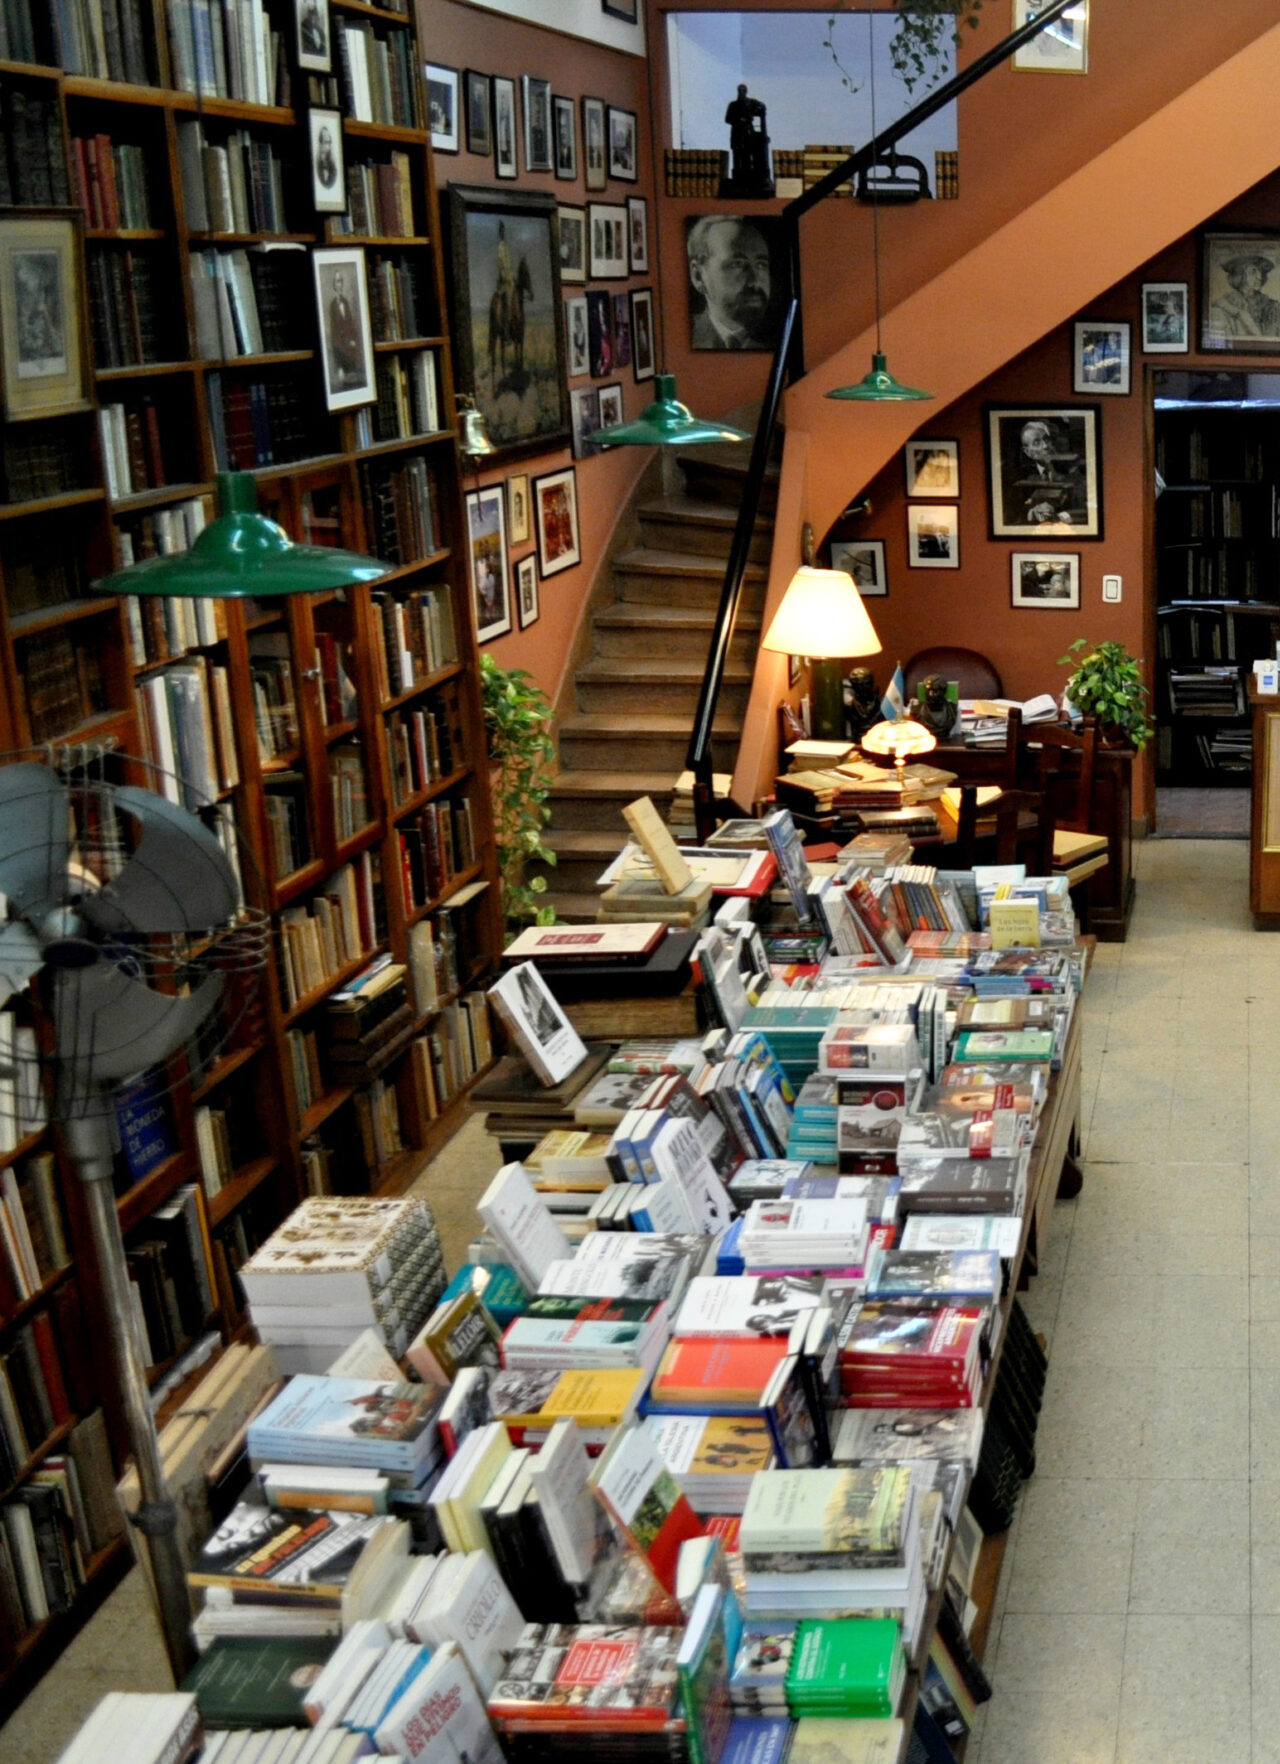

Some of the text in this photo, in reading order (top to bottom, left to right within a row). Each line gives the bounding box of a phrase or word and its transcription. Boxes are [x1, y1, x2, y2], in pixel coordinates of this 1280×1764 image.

[126, 1106, 166, 1136] MONEDA
[129, 1137, 141, 1153] DE
[452, 1314, 484, 1357] LELOIR
[465, 1579, 500, 1641] CRIOLLO
[401, 1711, 422, 1738] LOS
[425, 1697, 461, 1742] PELIGRO
